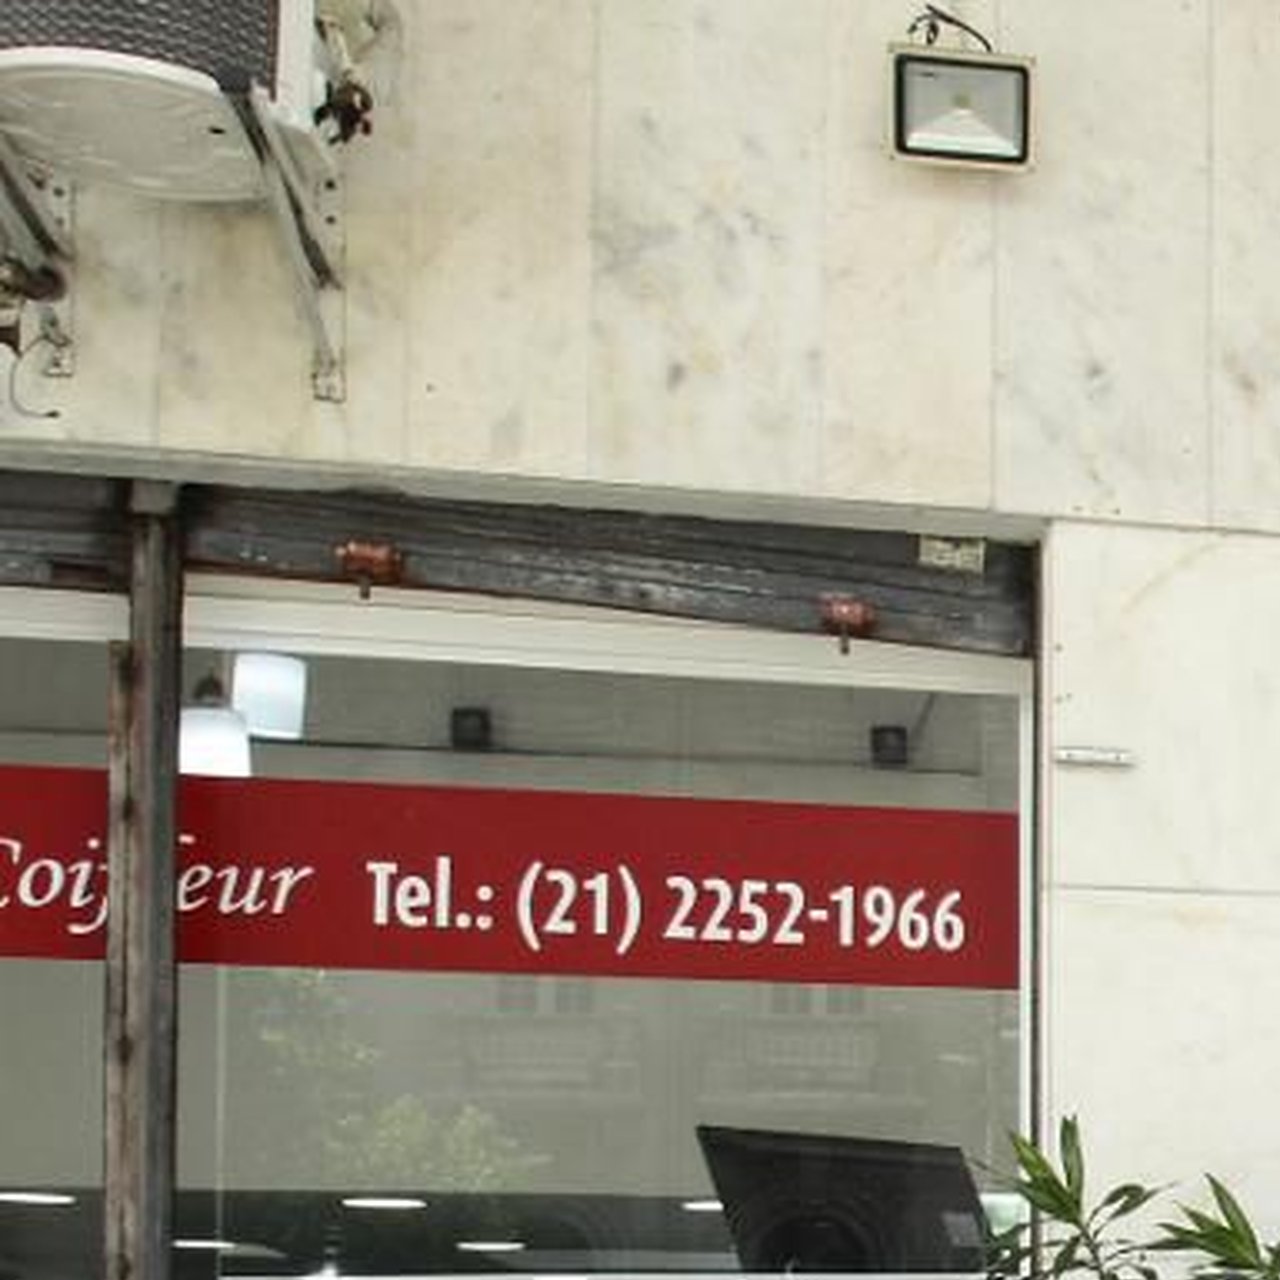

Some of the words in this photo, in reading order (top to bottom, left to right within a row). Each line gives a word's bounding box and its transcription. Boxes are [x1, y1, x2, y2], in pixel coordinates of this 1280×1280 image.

[0, 834, 315, 935] oieur
[366, 856, 494, 930] Tel.:
[516, 860, 642, 955] (21)
[662, 876, 966, 951] 2252-1966
